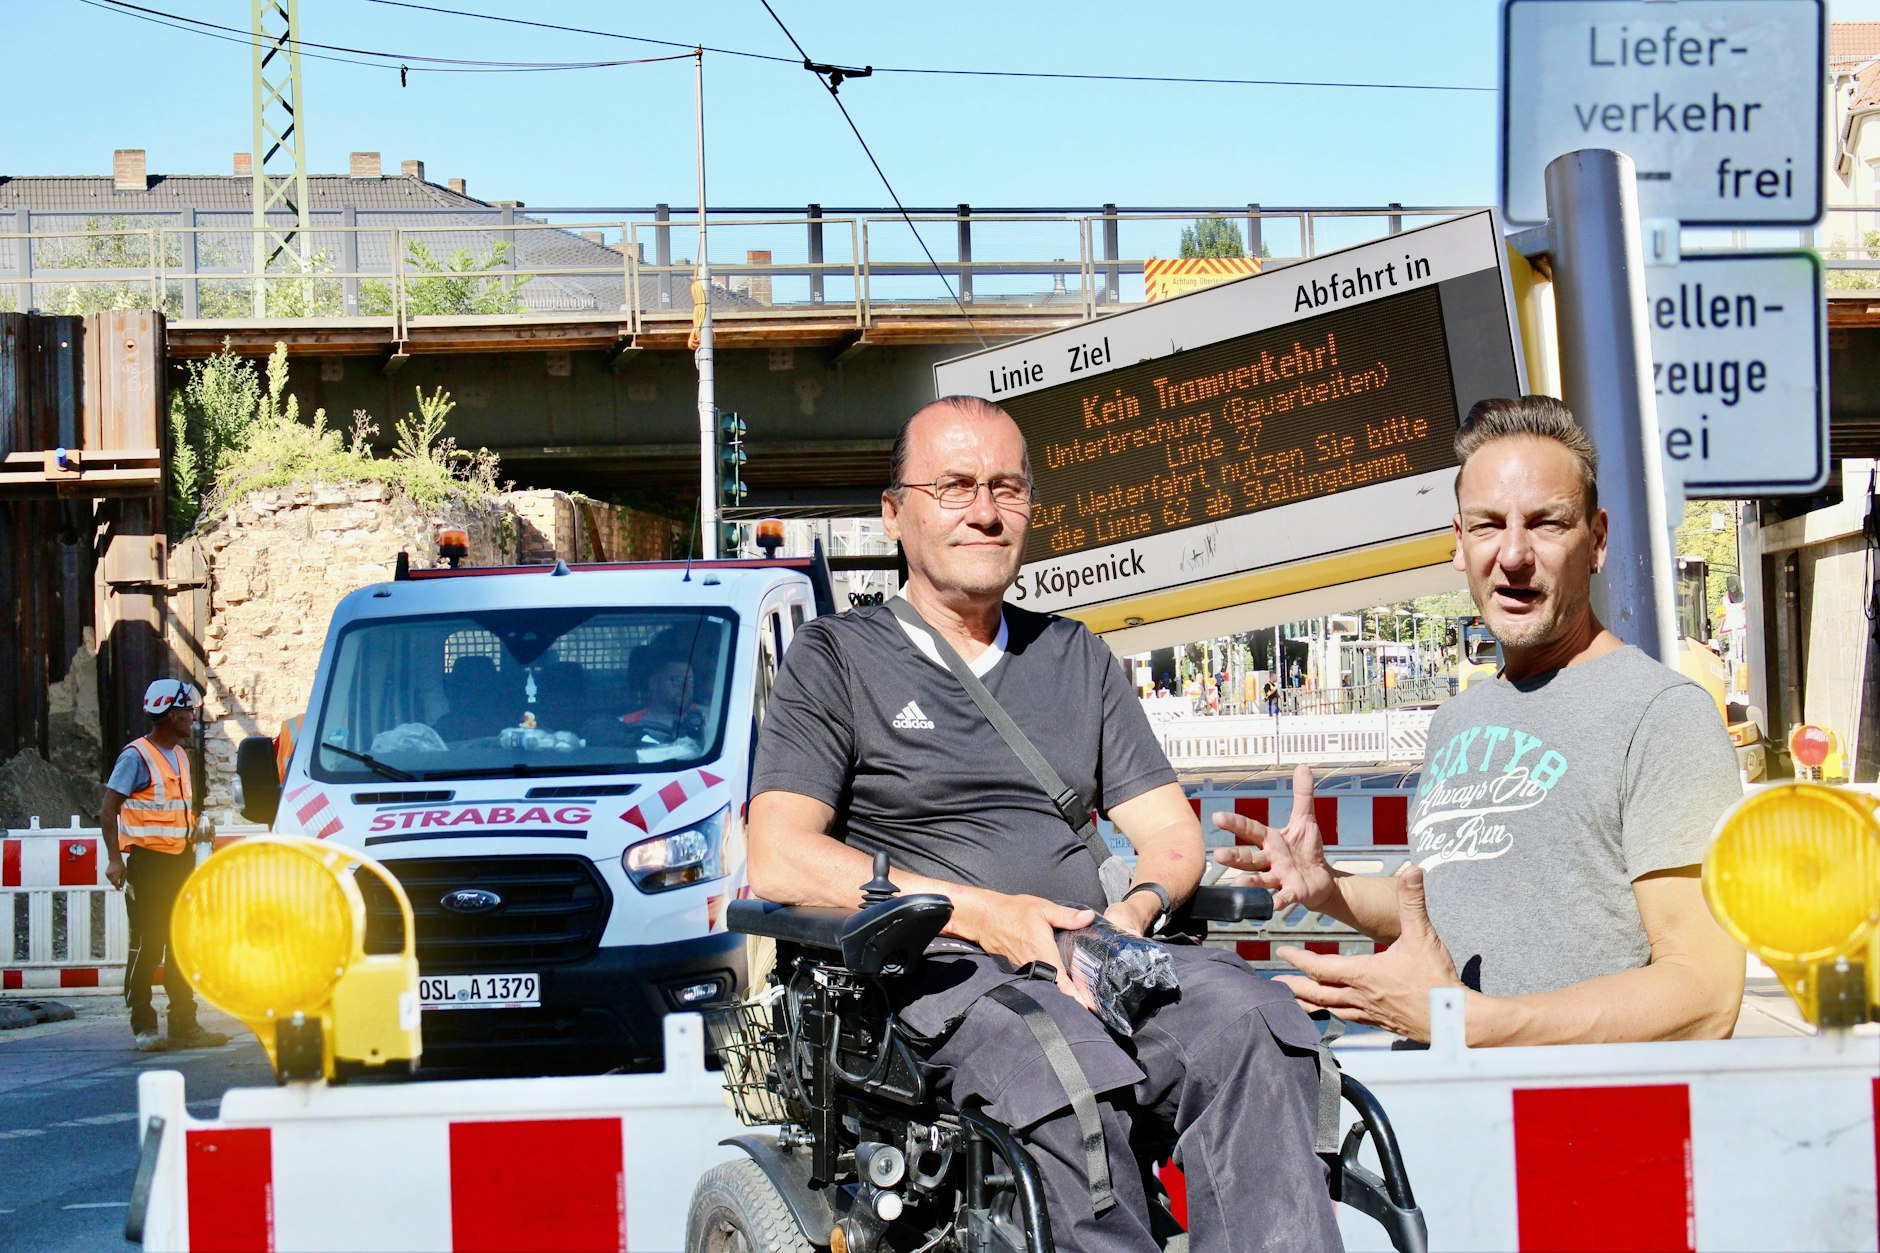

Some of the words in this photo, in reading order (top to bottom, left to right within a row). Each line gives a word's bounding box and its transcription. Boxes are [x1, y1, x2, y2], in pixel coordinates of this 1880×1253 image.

[1589, 26, 1748, 67] Liefer-
[1574, 92, 1762, 133] verkehr
[1717, 157, 1794, 199] frei
[1172, 277, 1197, 289] Achtung
[1294, 262, 1398, 313] Abfahrt
[1405, 254, 1431, 282] in
[1648, 283, 1783, 329] ellen-
[1067, 336, 1112, 373] Ziel
[989, 360, 1044, 394] Linie
[1082, 389, 1140, 429] Kein
[1153, 333, 1338, 409] Tramverkehr!
[1046, 412, 1212, 469] Unterbrechung
[1223, 361, 1389, 424] (Bauarbeiten)
[1166, 438, 1224, 468] Linie
[1236, 421, 1263, 451] 27
[1659, 414, 1710, 460] ei
[1031, 503, 1066, 529] Zur
[1077, 464, 1211, 517] Weiterfahrt
[1221, 448, 1304, 483] nutzen
[1315, 432, 1355, 461] Sie
[1366, 415, 1428, 449] bitte
[1051, 525, 1085, 551] die
[1095, 510, 1151, 542] Linie
[1163, 497, 1191, 526] 62
[1205, 489, 1233, 516] ab
[1243, 454, 1413, 507] Stellingdamm.
[1014, 575, 1027, 601] S
[1035, 548, 1146, 597] Köpenick
[892, 718, 936, 730] adidas
[1489, 766, 1547, 804] On
[368, 806, 593, 832] STRABAG
[1441, 814, 1507, 858] Run
[452, 893, 486, 908] Ford
[420, 979, 456, 1000] OSL
[470, 978, 481, 999] A
[486, 978, 536, 999] 1379
